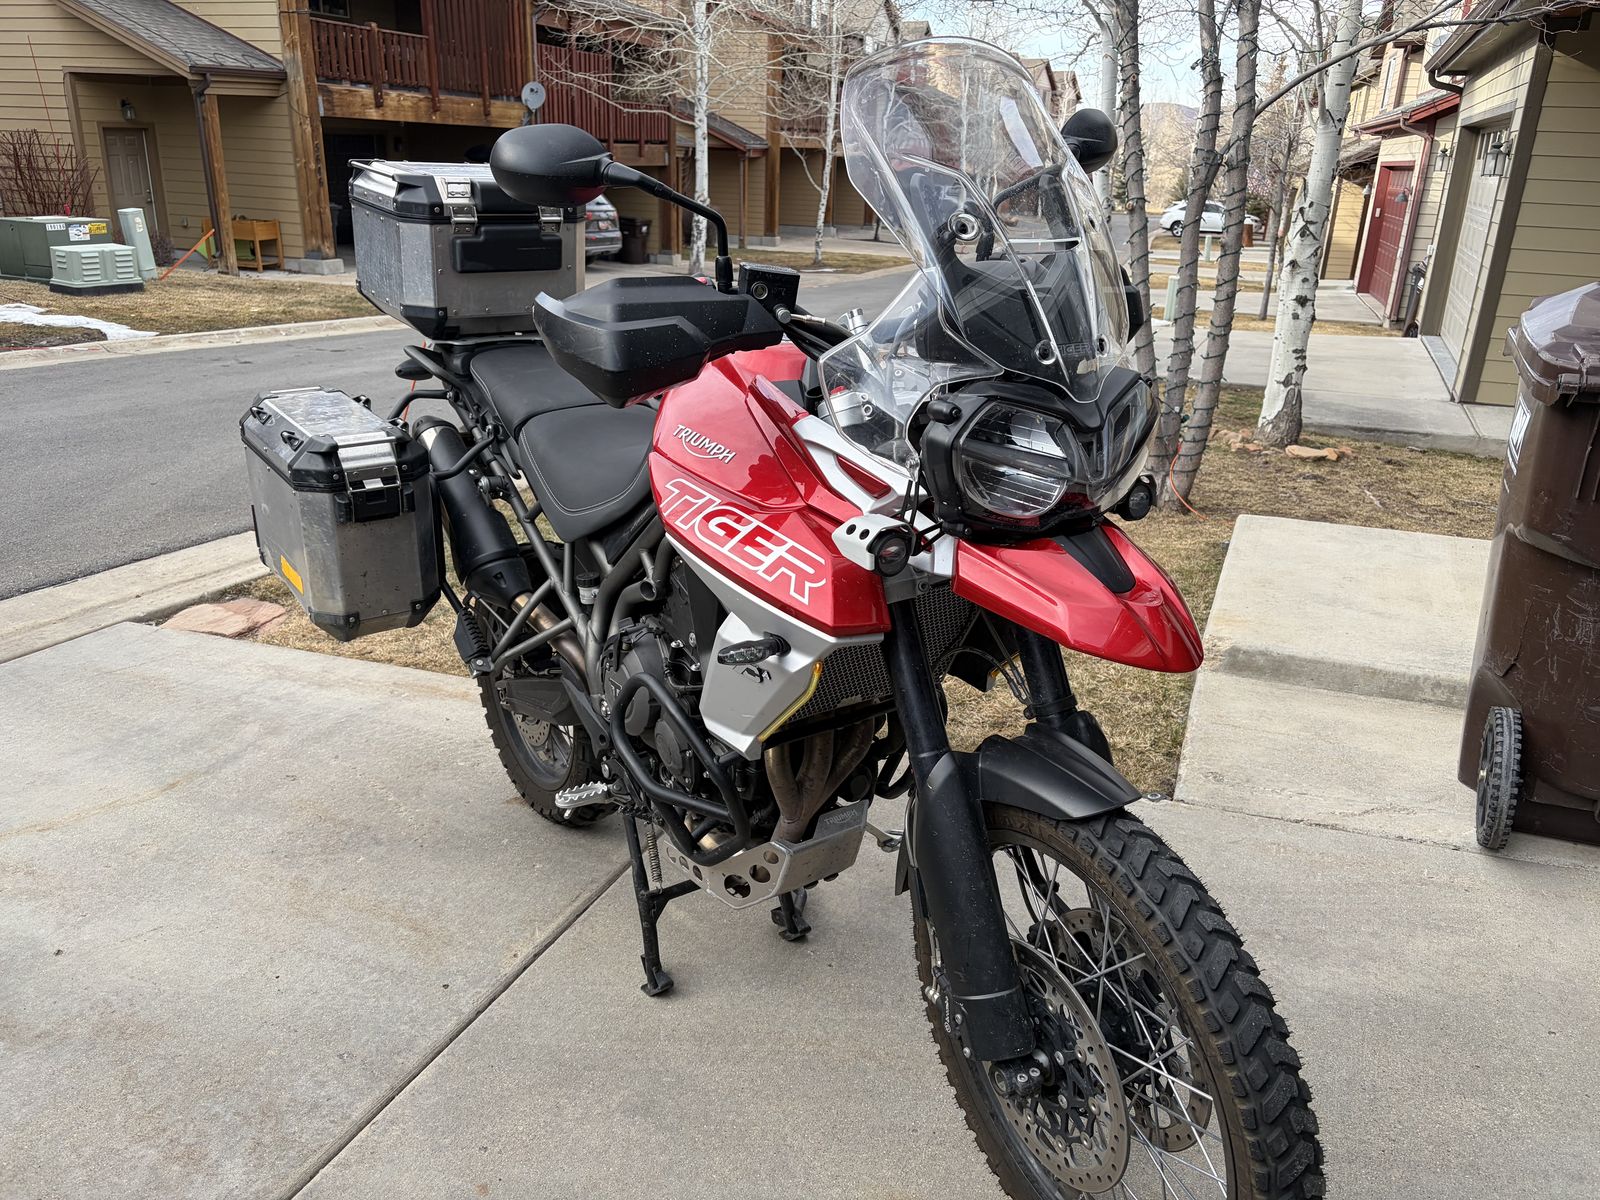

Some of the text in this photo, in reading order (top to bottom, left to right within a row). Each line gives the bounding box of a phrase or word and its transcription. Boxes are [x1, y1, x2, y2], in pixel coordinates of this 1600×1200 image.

[672, 424, 736, 464] TRIUMPH
[659, 478, 827, 606] TIGER
[823, 809, 858, 825] TRIUMPH
